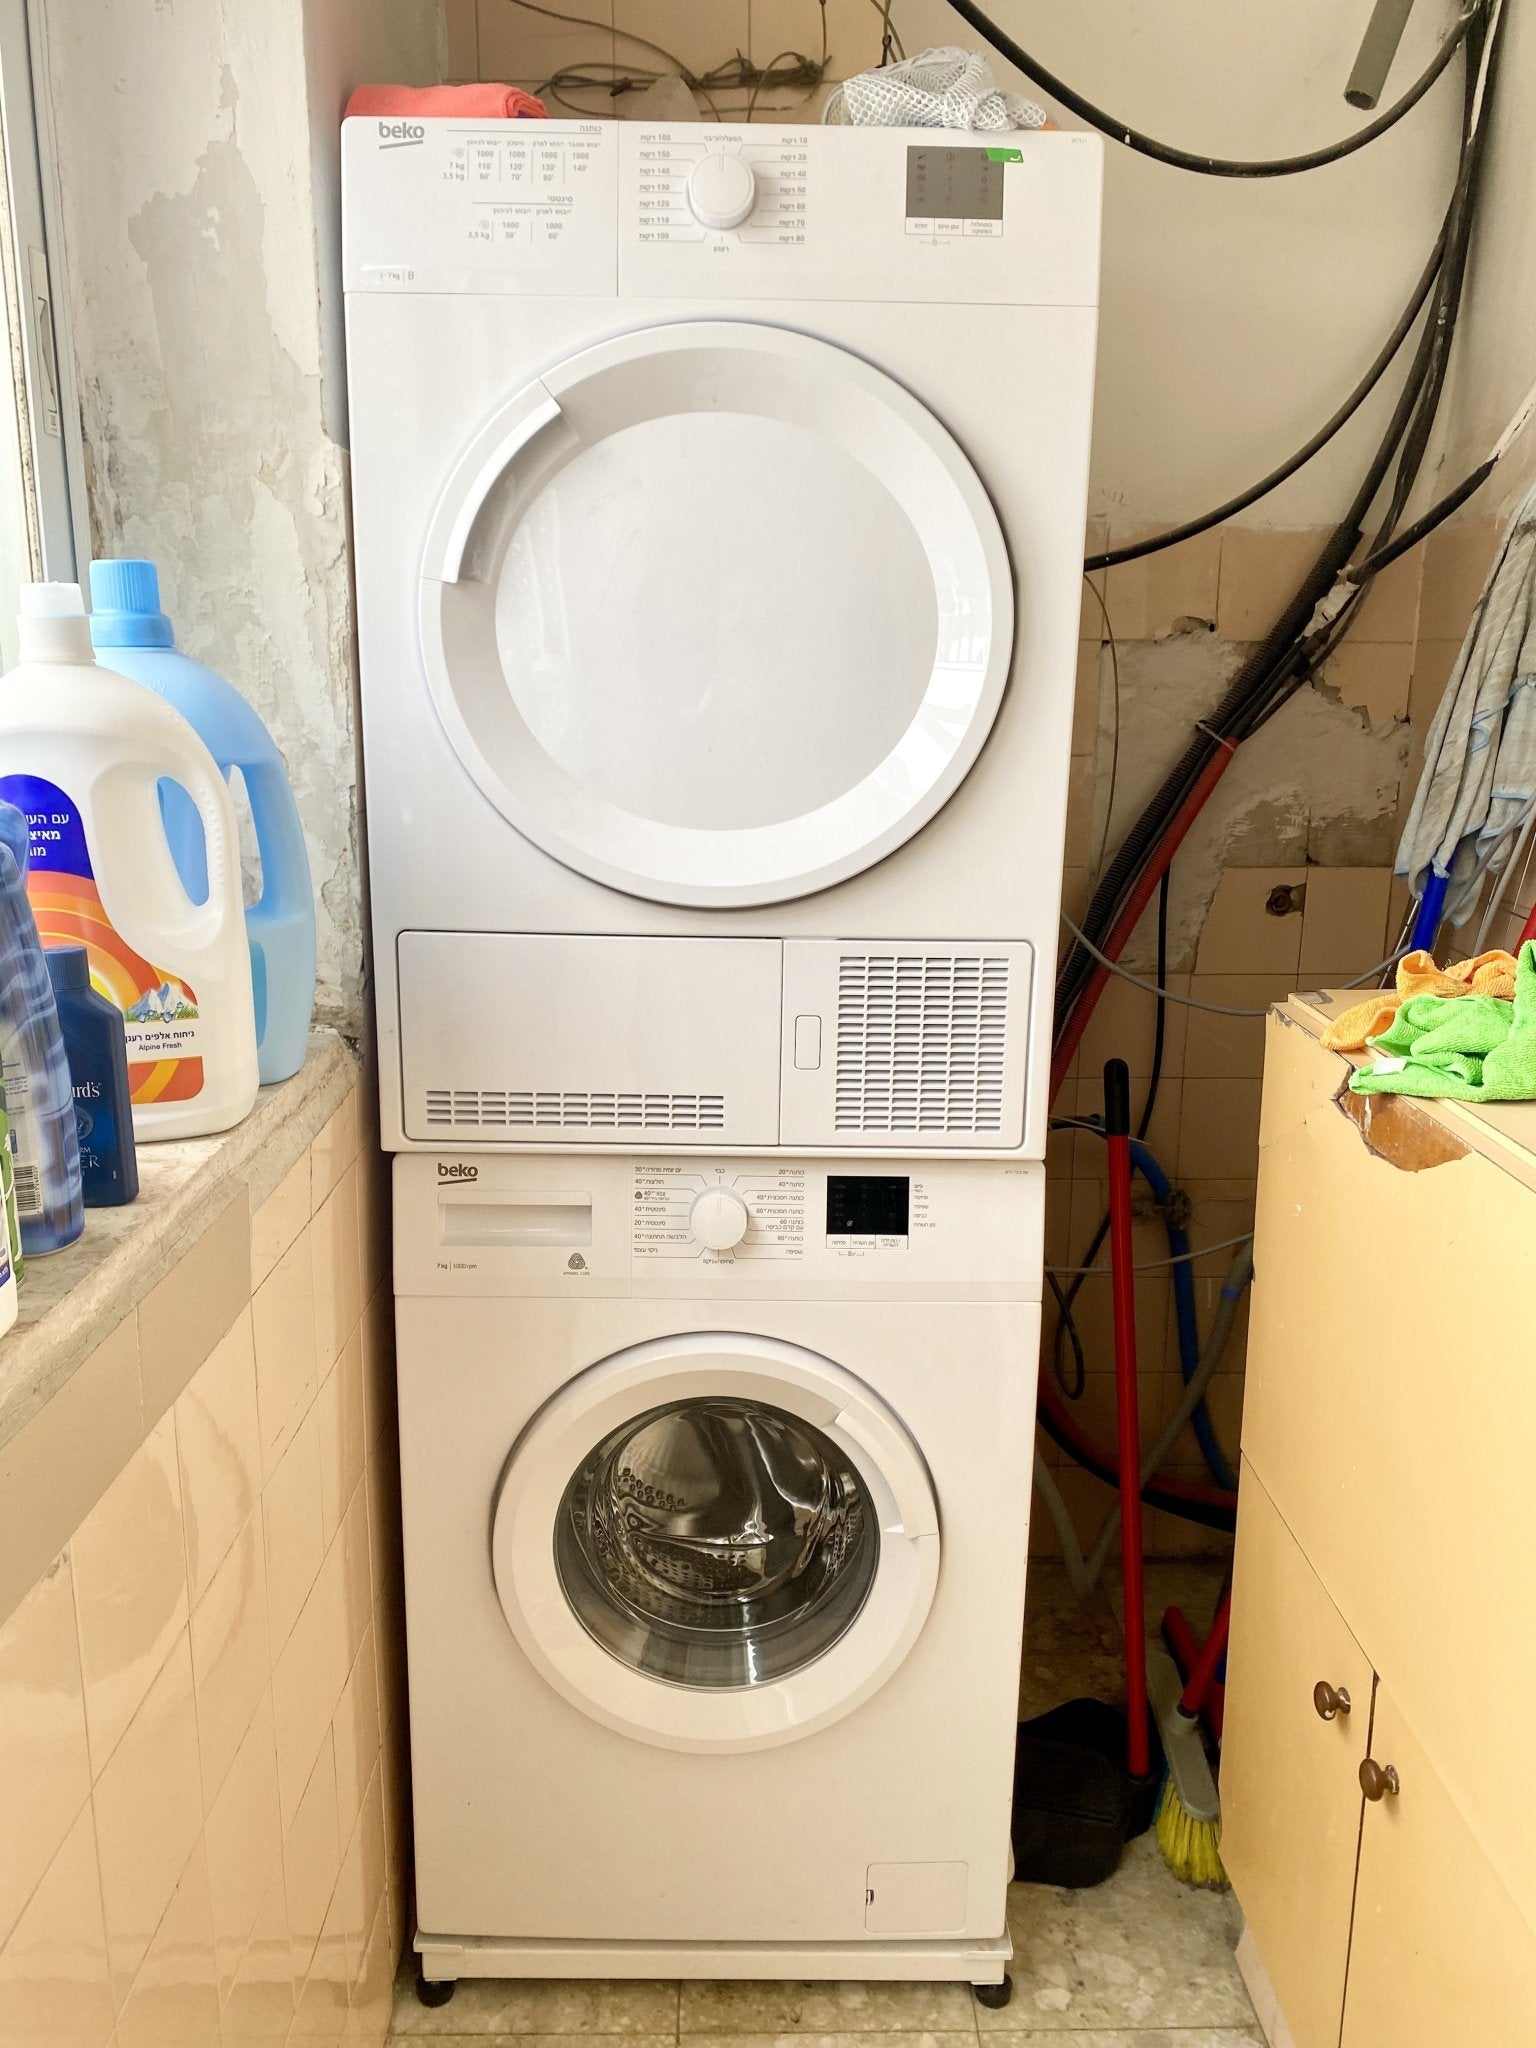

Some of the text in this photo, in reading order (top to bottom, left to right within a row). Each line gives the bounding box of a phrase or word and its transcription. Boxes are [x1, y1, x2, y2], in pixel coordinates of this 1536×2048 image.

[379, 121, 425, 139] beko
[477, 150, 494, 158] 1000
[541, 151, 558, 159] 1000
[455, 162, 464, 170] kg
[455, 172, 464, 181] kg
[502, 221, 519, 229] 1000
[546, 222, 563, 230] 1000
[480, 231, 490, 240] kg
[51, 813, 69, 824] עם
[125, 1030, 195, 1044] ניחוח אלפים רענן
[162, 1042, 182, 1050] Fresh
[437, 1163, 478, 1177] beko
